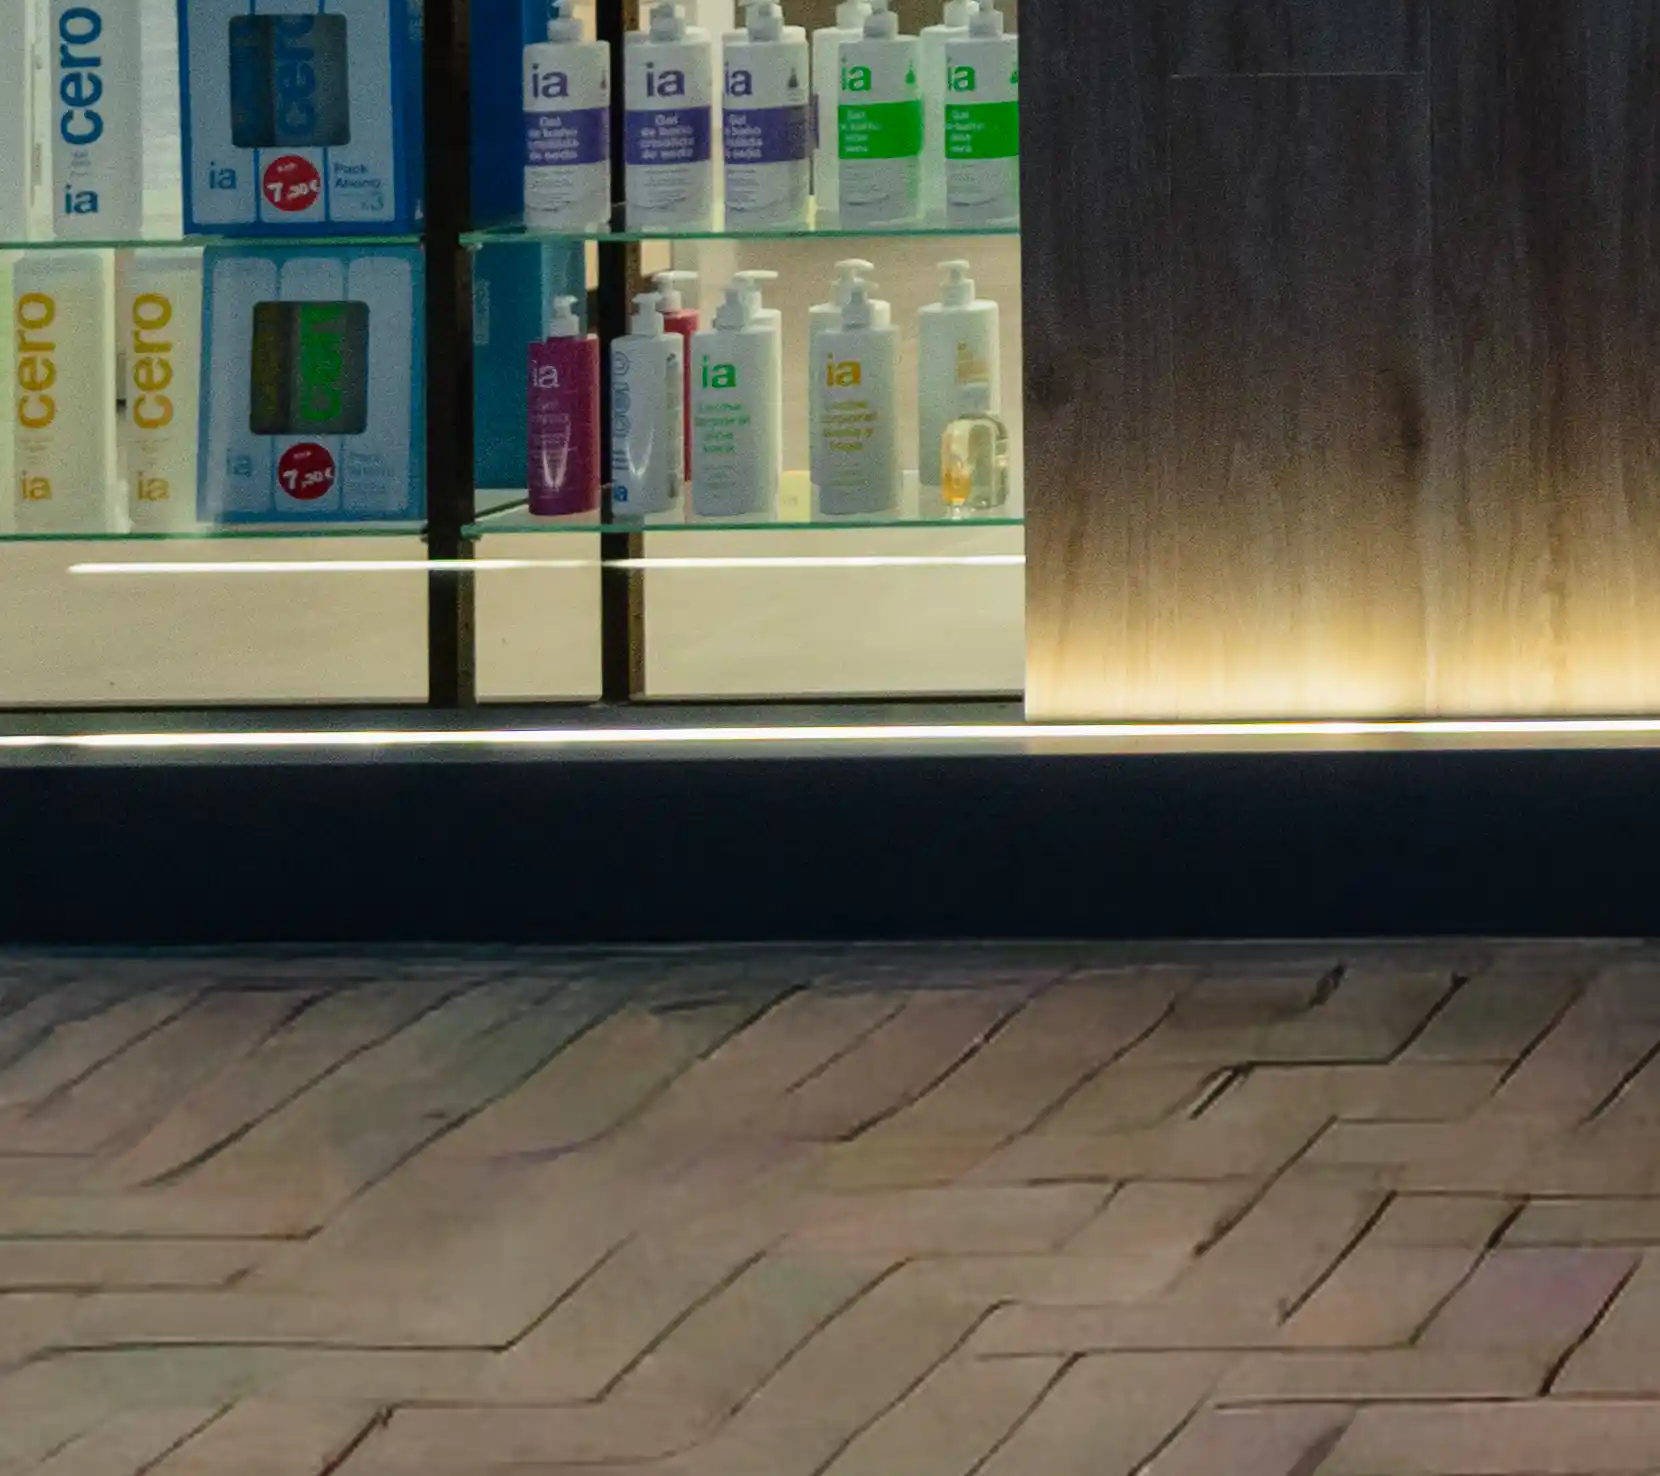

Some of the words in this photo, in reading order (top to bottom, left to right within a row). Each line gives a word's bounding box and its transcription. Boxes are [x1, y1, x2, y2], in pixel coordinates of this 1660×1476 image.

[59, 6, 103, 146] cero
[531, 62, 569, 99] ia
[646, 61, 686, 98] ia
[724, 61, 753, 97] ia
[841, 56, 872, 92] ia
[947, 56, 976, 92] ia
[208, 160, 236, 190] ia
[65, 186, 99, 216] ia
[17, 293, 56, 430] cero
[132, 292, 174, 430] cero
[531, 351, 560, 389] ia
[701, 355, 737, 389] ia
[825, 352, 862, 386] ia
[20, 473, 52, 502] ia
[138, 470, 170, 502] ia
